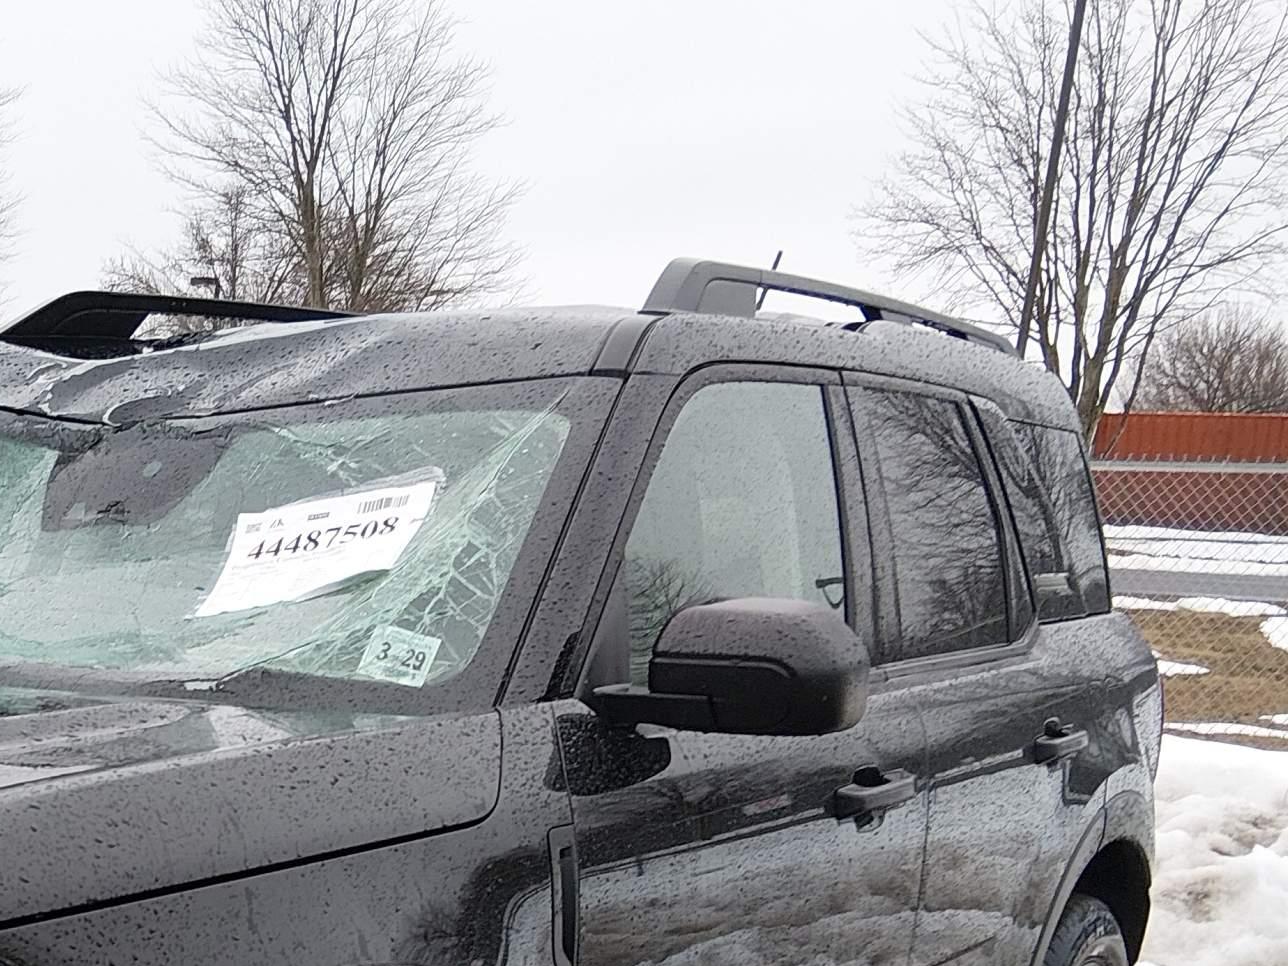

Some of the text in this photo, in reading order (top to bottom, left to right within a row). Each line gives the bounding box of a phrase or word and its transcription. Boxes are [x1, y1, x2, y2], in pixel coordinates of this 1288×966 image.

[247, 516, 400, 559] 44487508
[376, 641, 392, 661] 3
[400, 648, 426, 671] 29
